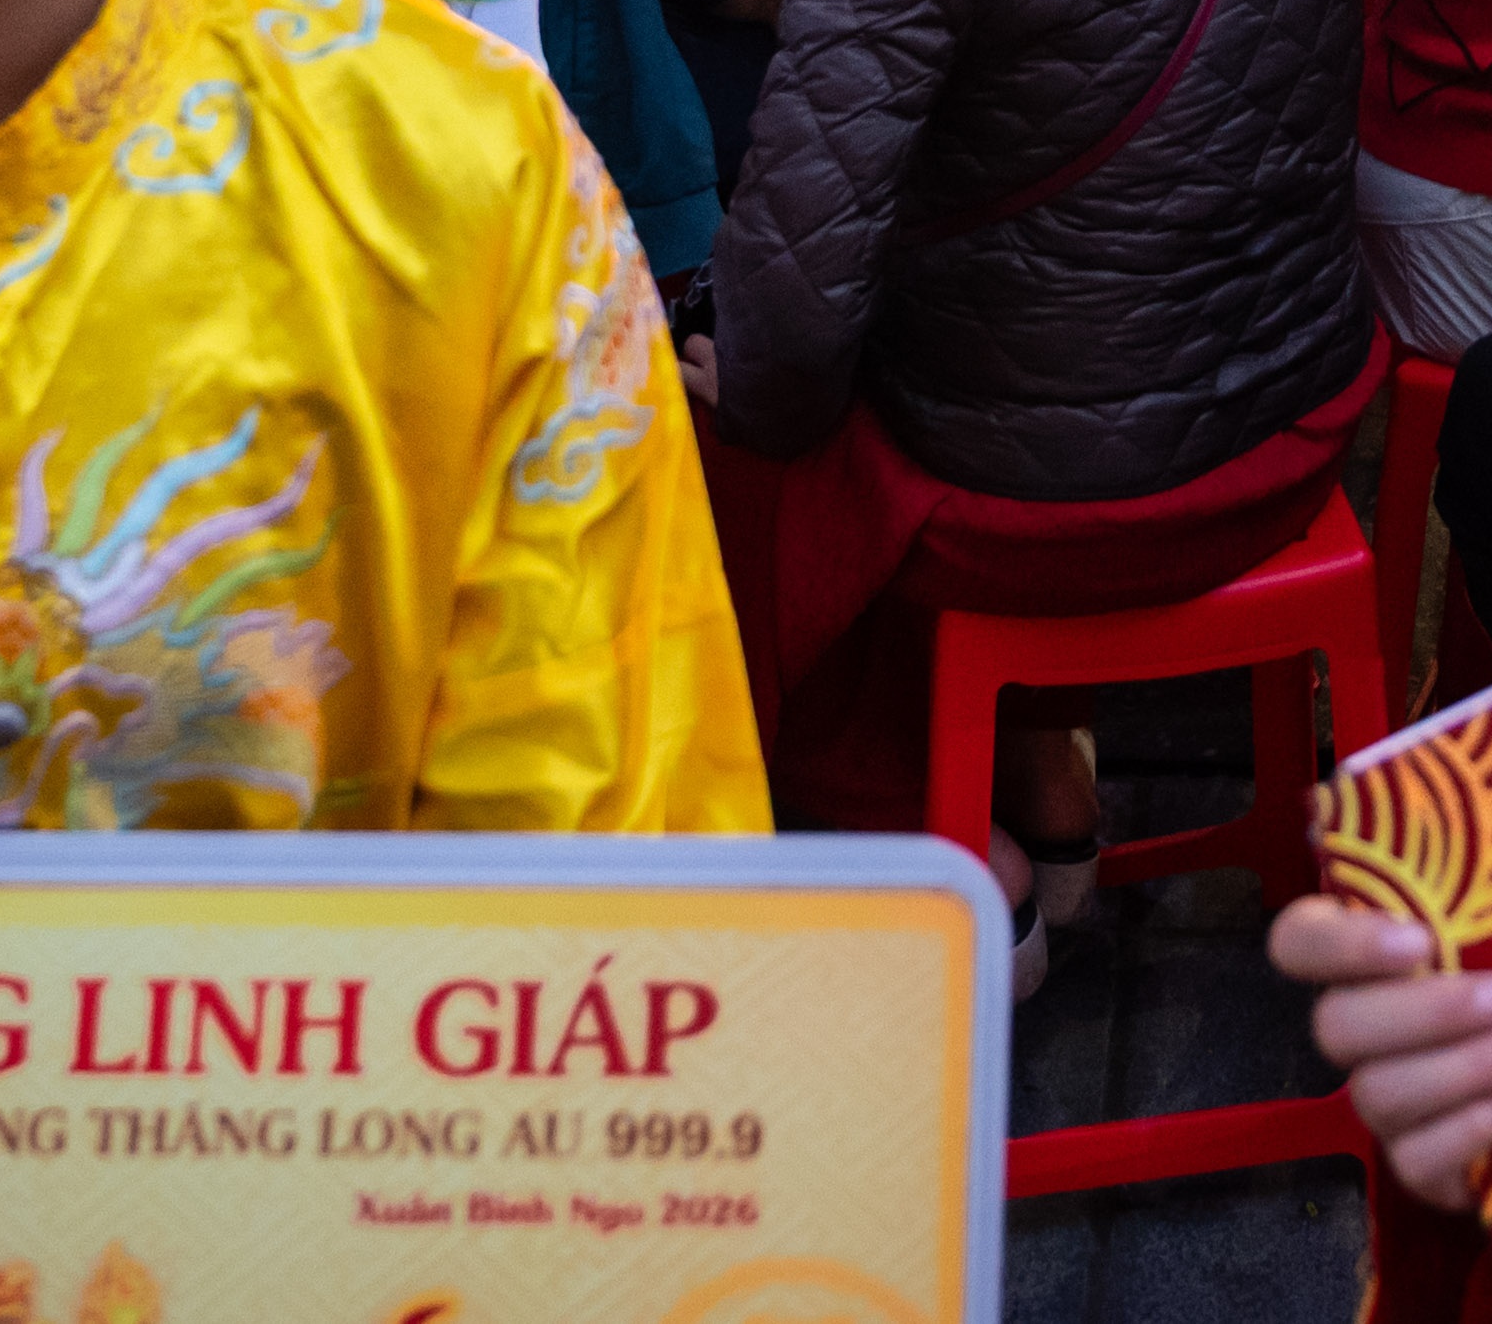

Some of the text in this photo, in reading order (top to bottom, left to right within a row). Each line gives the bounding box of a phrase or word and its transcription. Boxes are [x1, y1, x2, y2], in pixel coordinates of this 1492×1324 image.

[66, 973, 372, 1081] LINH
[413, 952, 721, 1080] GIÁP
[83, 1098, 299, 1159] THĂNG
[316, 1108, 483, 1159] LONG
[501, 1109, 585, 1158] AU
[604, 1109, 765, 1161] 999.9
